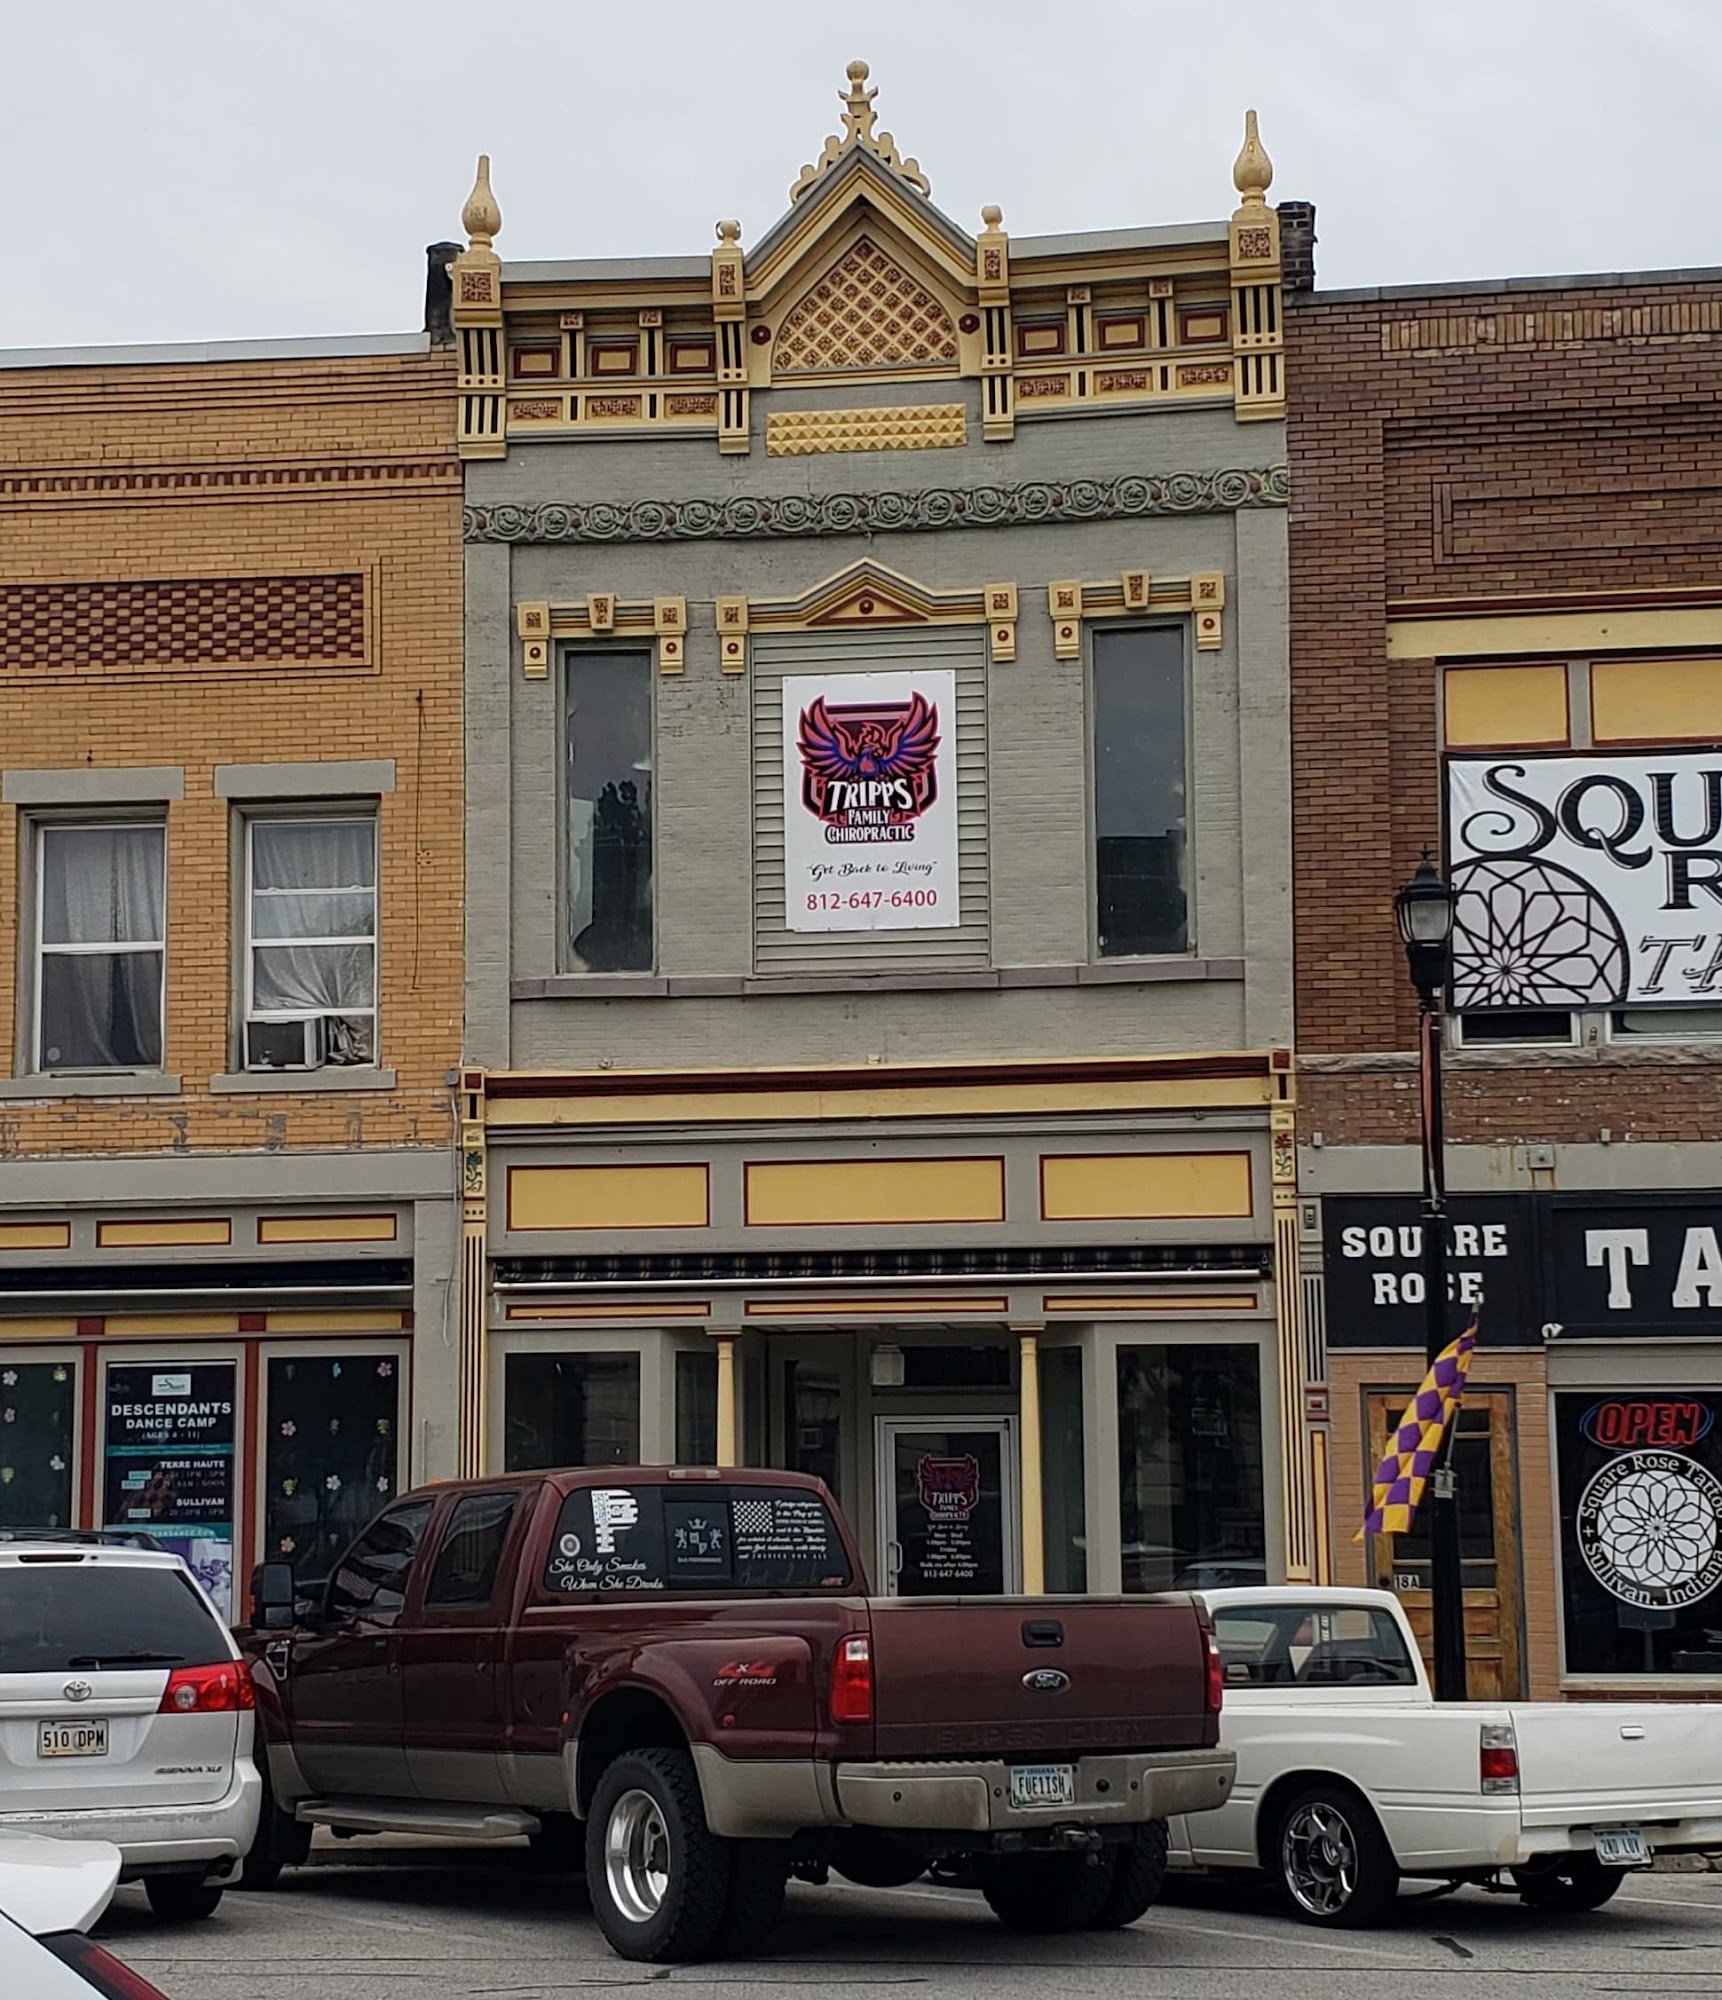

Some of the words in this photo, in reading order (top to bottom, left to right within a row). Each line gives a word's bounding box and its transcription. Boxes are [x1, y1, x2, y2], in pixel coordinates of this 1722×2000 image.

[827, 778, 913, 813] TRIPPS
[848, 808, 890, 825] FAMILY
[827, 825, 914, 842] CHIROPRACTIC
[838, 862, 871, 877] Back
[876, 863, 888, 872] to
[806, 889, 938, 911] 812-647-6400
[1341, 1224, 1508, 1258] SQURE
[111, 1402, 232, 1416] DESCENDANTS
[126, 1418, 173, 1429] DANCE
[177, 1417, 216, 1428] CAMP
[1596, 1403, 1700, 1445] OPEN
[160, 1461, 191, 1469] TERRE
[193, 1460, 225, 1468] HAUTE
[1580, 1462, 1629, 1519] Square
[1632, 1454, 1680, 1471] Rose
[176, 1498, 225, 1506] SULLIVAN
[549, 1558, 575, 1573] She
[605, 1557, 647, 1572] Smokes
[560, 1575, 597, 1591] When
[600, 1575, 624, 1590] She
[625, 1575, 664, 1589] Drinks
[1395, 1575, 1420, 1589] 18A
[713, 1678, 735, 1686] OFF
[739, 1677, 777, 1686] ROAD
[1035, 1673, 1061, 1688] Ford
[43, 1731, 69, 1747] 510
